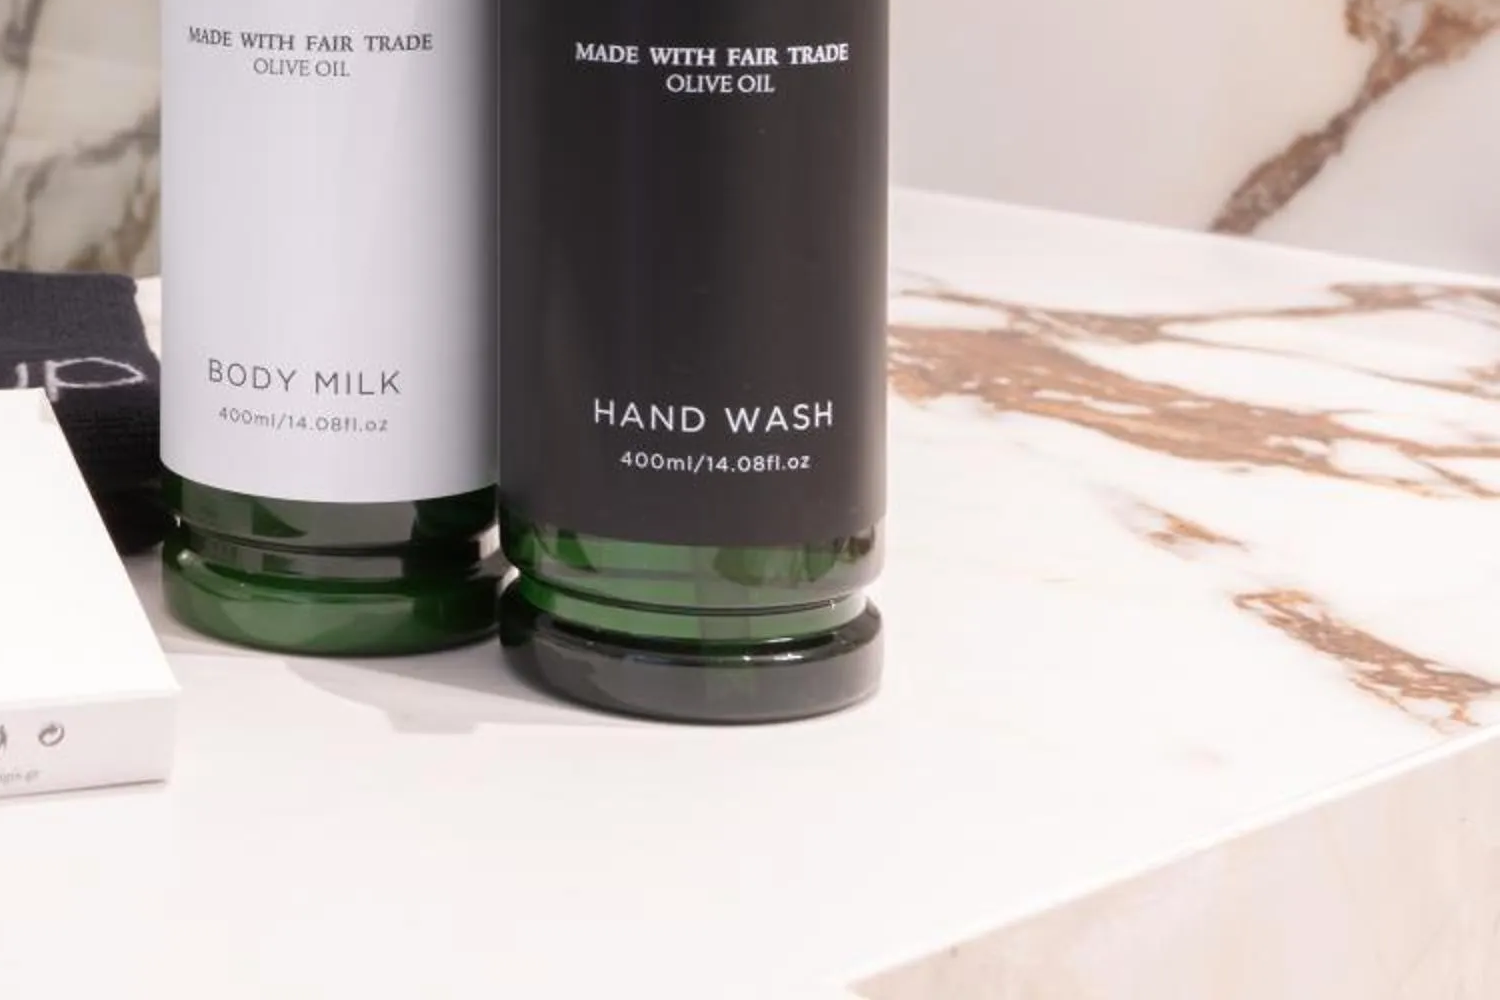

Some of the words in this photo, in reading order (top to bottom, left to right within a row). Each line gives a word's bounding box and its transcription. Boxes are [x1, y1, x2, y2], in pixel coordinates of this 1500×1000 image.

[187, 26, 233, 49] MADE
[240, 31, 295, 52] WITH
[305, 34, 354, 53] FAIR
[363, 33, 434, 53] TRADE
[252, 56, 311, 77] OLIVE
[314, 59, 351, 79] OIL
[575, 42, 640, 66] MADE
[648, 46, 716, 66] WITH
[727, 47, 780, 67] FAIR
[786, 43, 850, 65] TRADE
[665, 73, 735, 94] OLIVE
[737, 73, 776, 94] OIL
[207, 357, 297, 393] BODY
[314, 369, 401, 396] MILK
[218, 405, 389, 434] 400ml/14.08fl.oz
[594, 398, 706, 433] HAND
[725, 400, 834, 434] WASH
[619, 450, 812, 475] 400ml/14.08fl.oz
